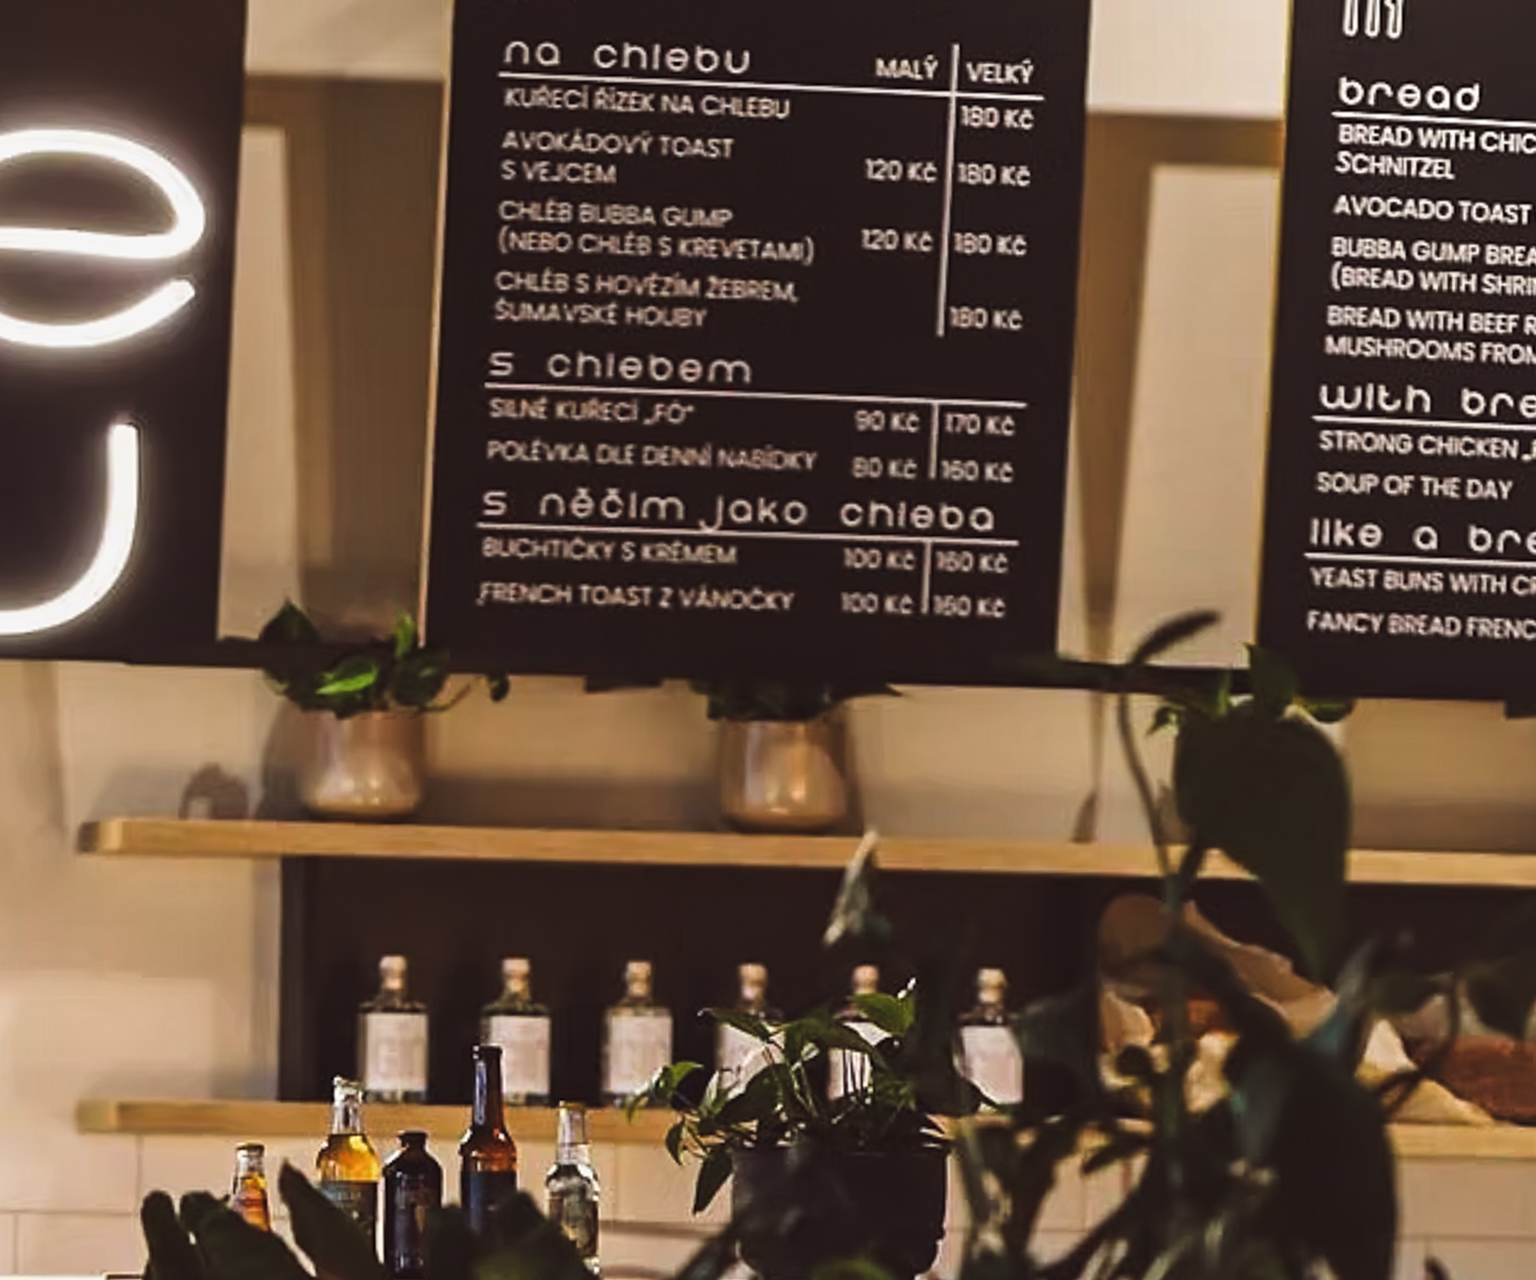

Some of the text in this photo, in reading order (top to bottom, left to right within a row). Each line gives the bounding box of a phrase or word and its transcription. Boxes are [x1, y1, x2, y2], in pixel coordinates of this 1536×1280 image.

[504, 40, 1034, 84] na chlebu MALÝ VELKÝ
[1338, 76, 1480, 112] bread
[660, 94, 695, 114] NA
[700, 94, 790, 120] CHLEBU
[960, 105, 1000, 129] 180
[1003, 108, 1034, 131] Kč
[502, 129, 734, 159] AVOKÁDOVÝ TOAST
[1338, 123, 1536, 155] BREAD WITH CHIC
[501, 158, 1031, 187] S VEJCEM 120 Kč 180 Kč
[1334, 150, 1456, 180] SCHNITZEL
[579, 202, 657, 225] BUBBA
[662, 206, 733, 228] GUMP
[1333, 194, 1533, 226] AVOCADO TOAST
[658, 235, 672, 257] S
[861, 228, 900, 251] 120
[903, 231, 933, 252] Kč
[996, 234, 1027, 257] Kč
[1330, 236, 1536, 267] BUBBA GUMP BREA
[575, 273, 590, 294] S
[1330, 260, 1478, 294] (BREAD WITH
[625, 305, 707, 328] HOUBY
[992, 309, 1023, 331] Kč
[1326, 304, 1520, 335] BREAD WITH BEEF
[1324, 334, 1476, 363] MUSHROOMS
[547, 352, 751, 383] chlebem
[1319, 382, 1431, 414] with
[890, 412, 920, 433] Kč
[945, 412, 981, 435] 170
[985, 415, 1015, 437] Kč
[1319, 429, 1414, 455] STRONG
[1417, 434, 1520, 460] CHICKEN
[596, 443, 634, 465] DLE
[984, 462, 1013, 483] Kč
[1317, 471, 1513, 500] SOUP OF THE DAY
[698, 495, 809, 532] jako
[840, 501, 994, 532] chleba
[1309, 517, 1438, 551] like a
[579, 584, 652, 607] TOAST
[1310, 566, 1507, 595] YEAST BUNS WITH
[1306, 609, 1385, 634] FANCY
[1388, 612, 1462, 637] BREAD
